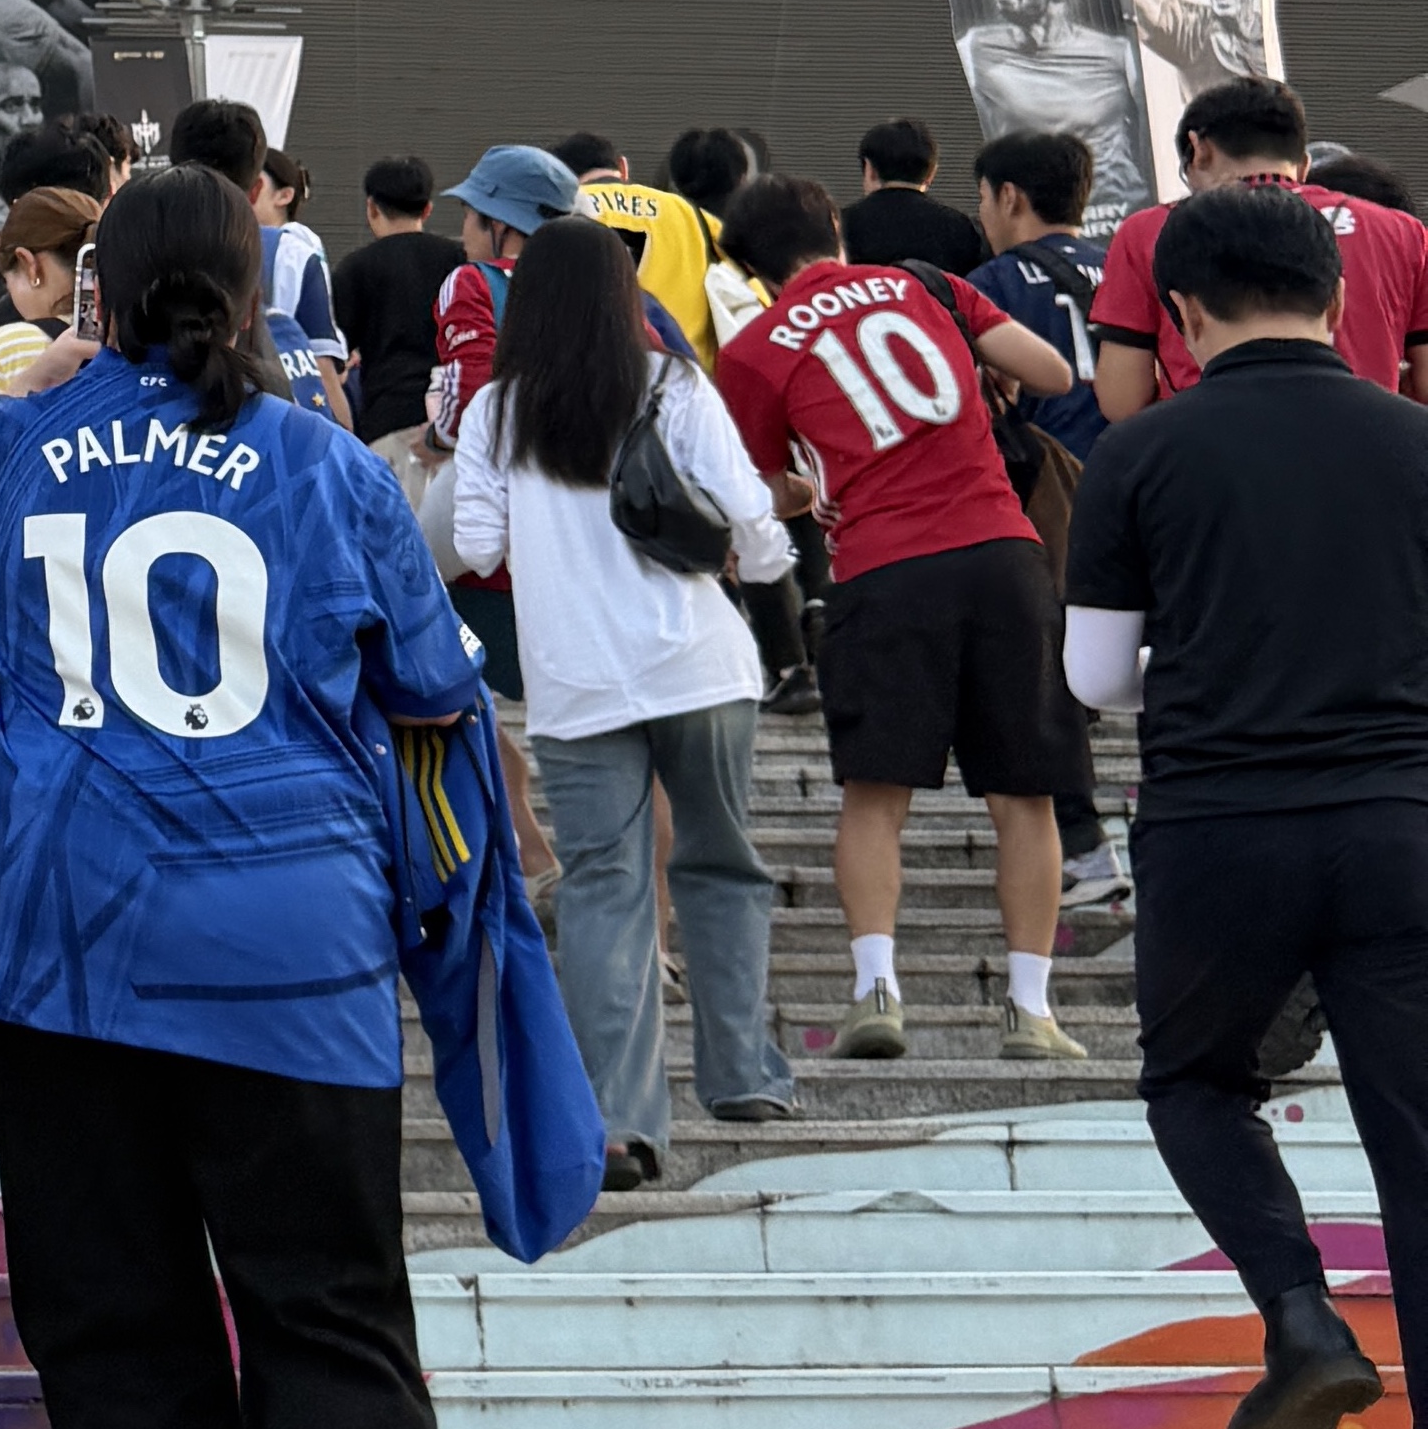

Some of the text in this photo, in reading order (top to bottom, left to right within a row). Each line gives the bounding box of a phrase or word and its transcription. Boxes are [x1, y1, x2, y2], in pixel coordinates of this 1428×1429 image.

[768, 276, 911, 353] ROONEY
[139, 375, 168, 388] CFC
[810, 310, 962, 453] 10
[41, 418, 261, 492] PALMER
[23, 510, 270, 739] 10
